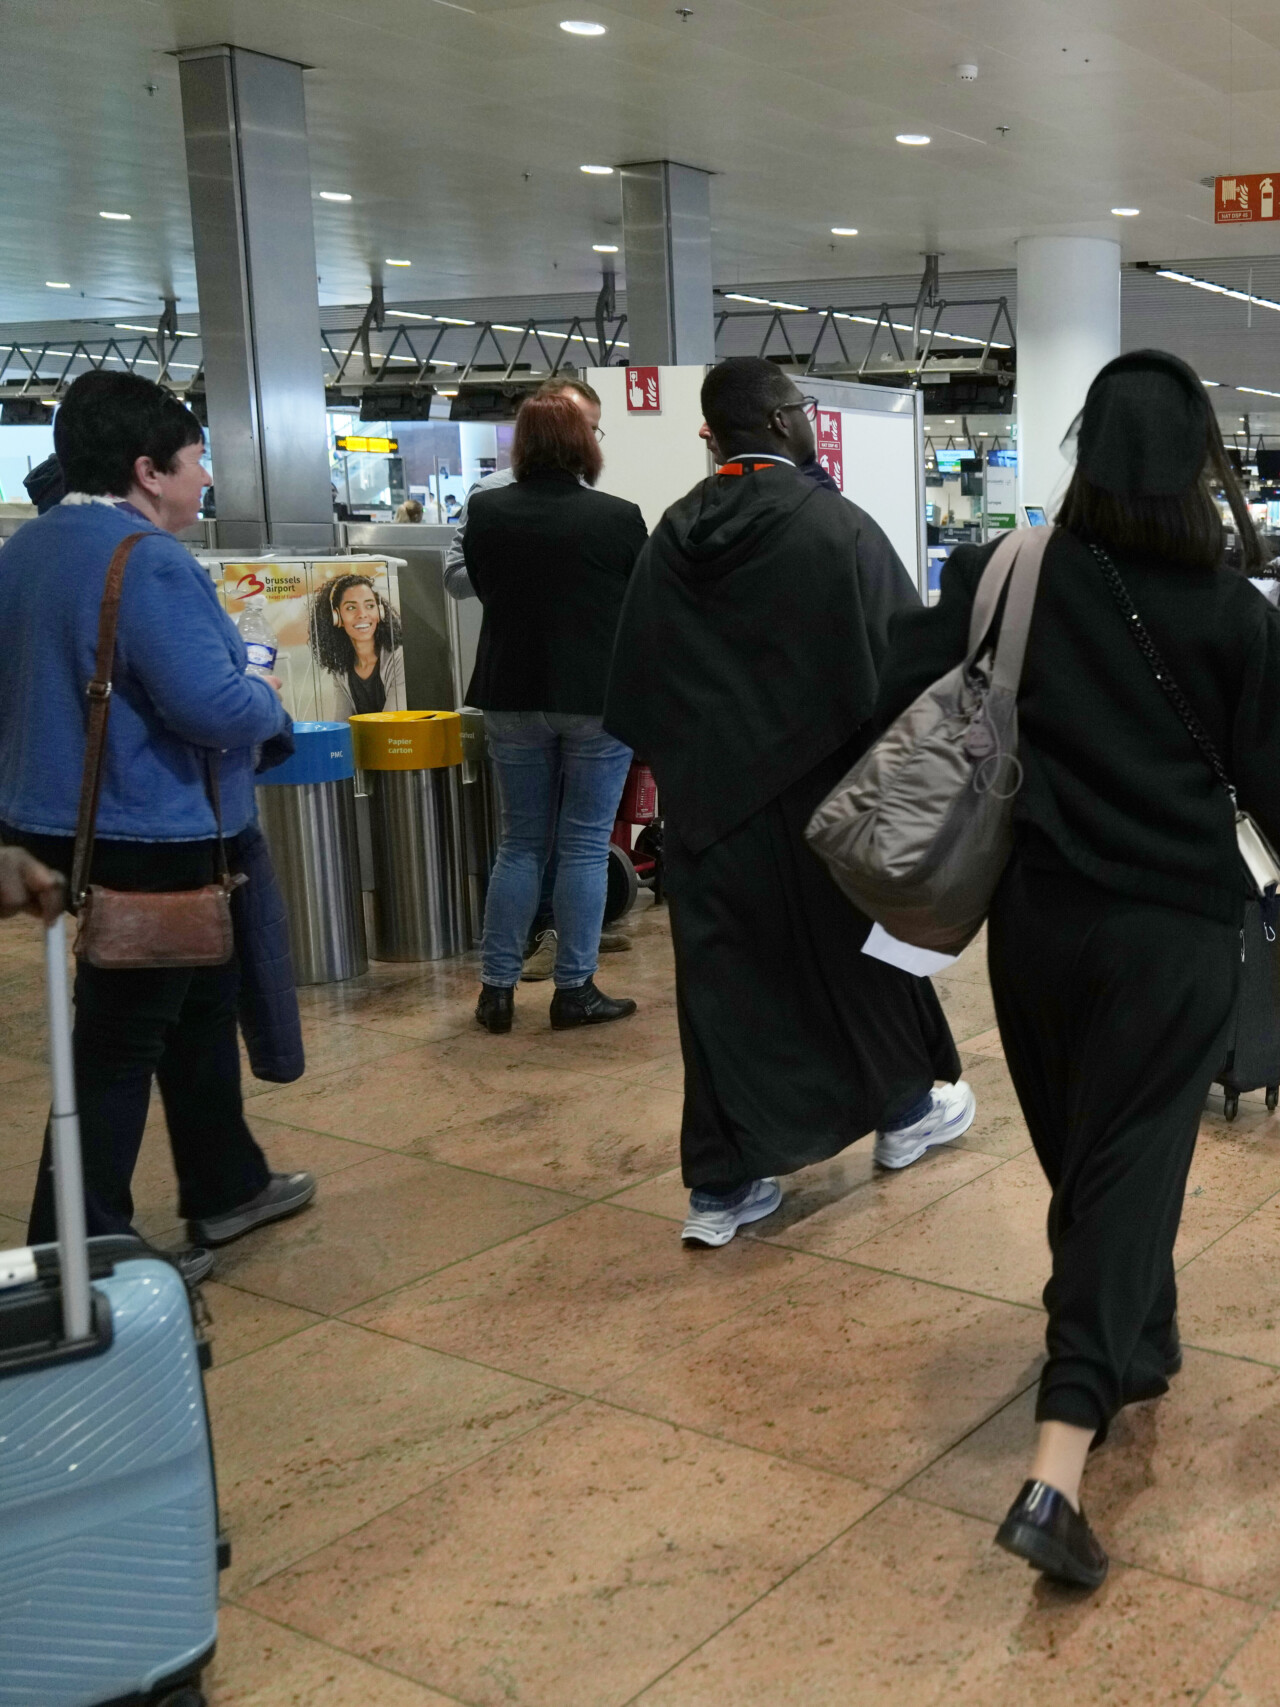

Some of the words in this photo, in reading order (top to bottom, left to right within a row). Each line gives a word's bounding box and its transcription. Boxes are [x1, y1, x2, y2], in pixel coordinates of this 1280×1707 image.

[265, 576, 301, 585] brussels
[266, 584, 296, 594] airport
[387, 738, 413, 746] Papier
[330, 750, 344, 759] PMC
